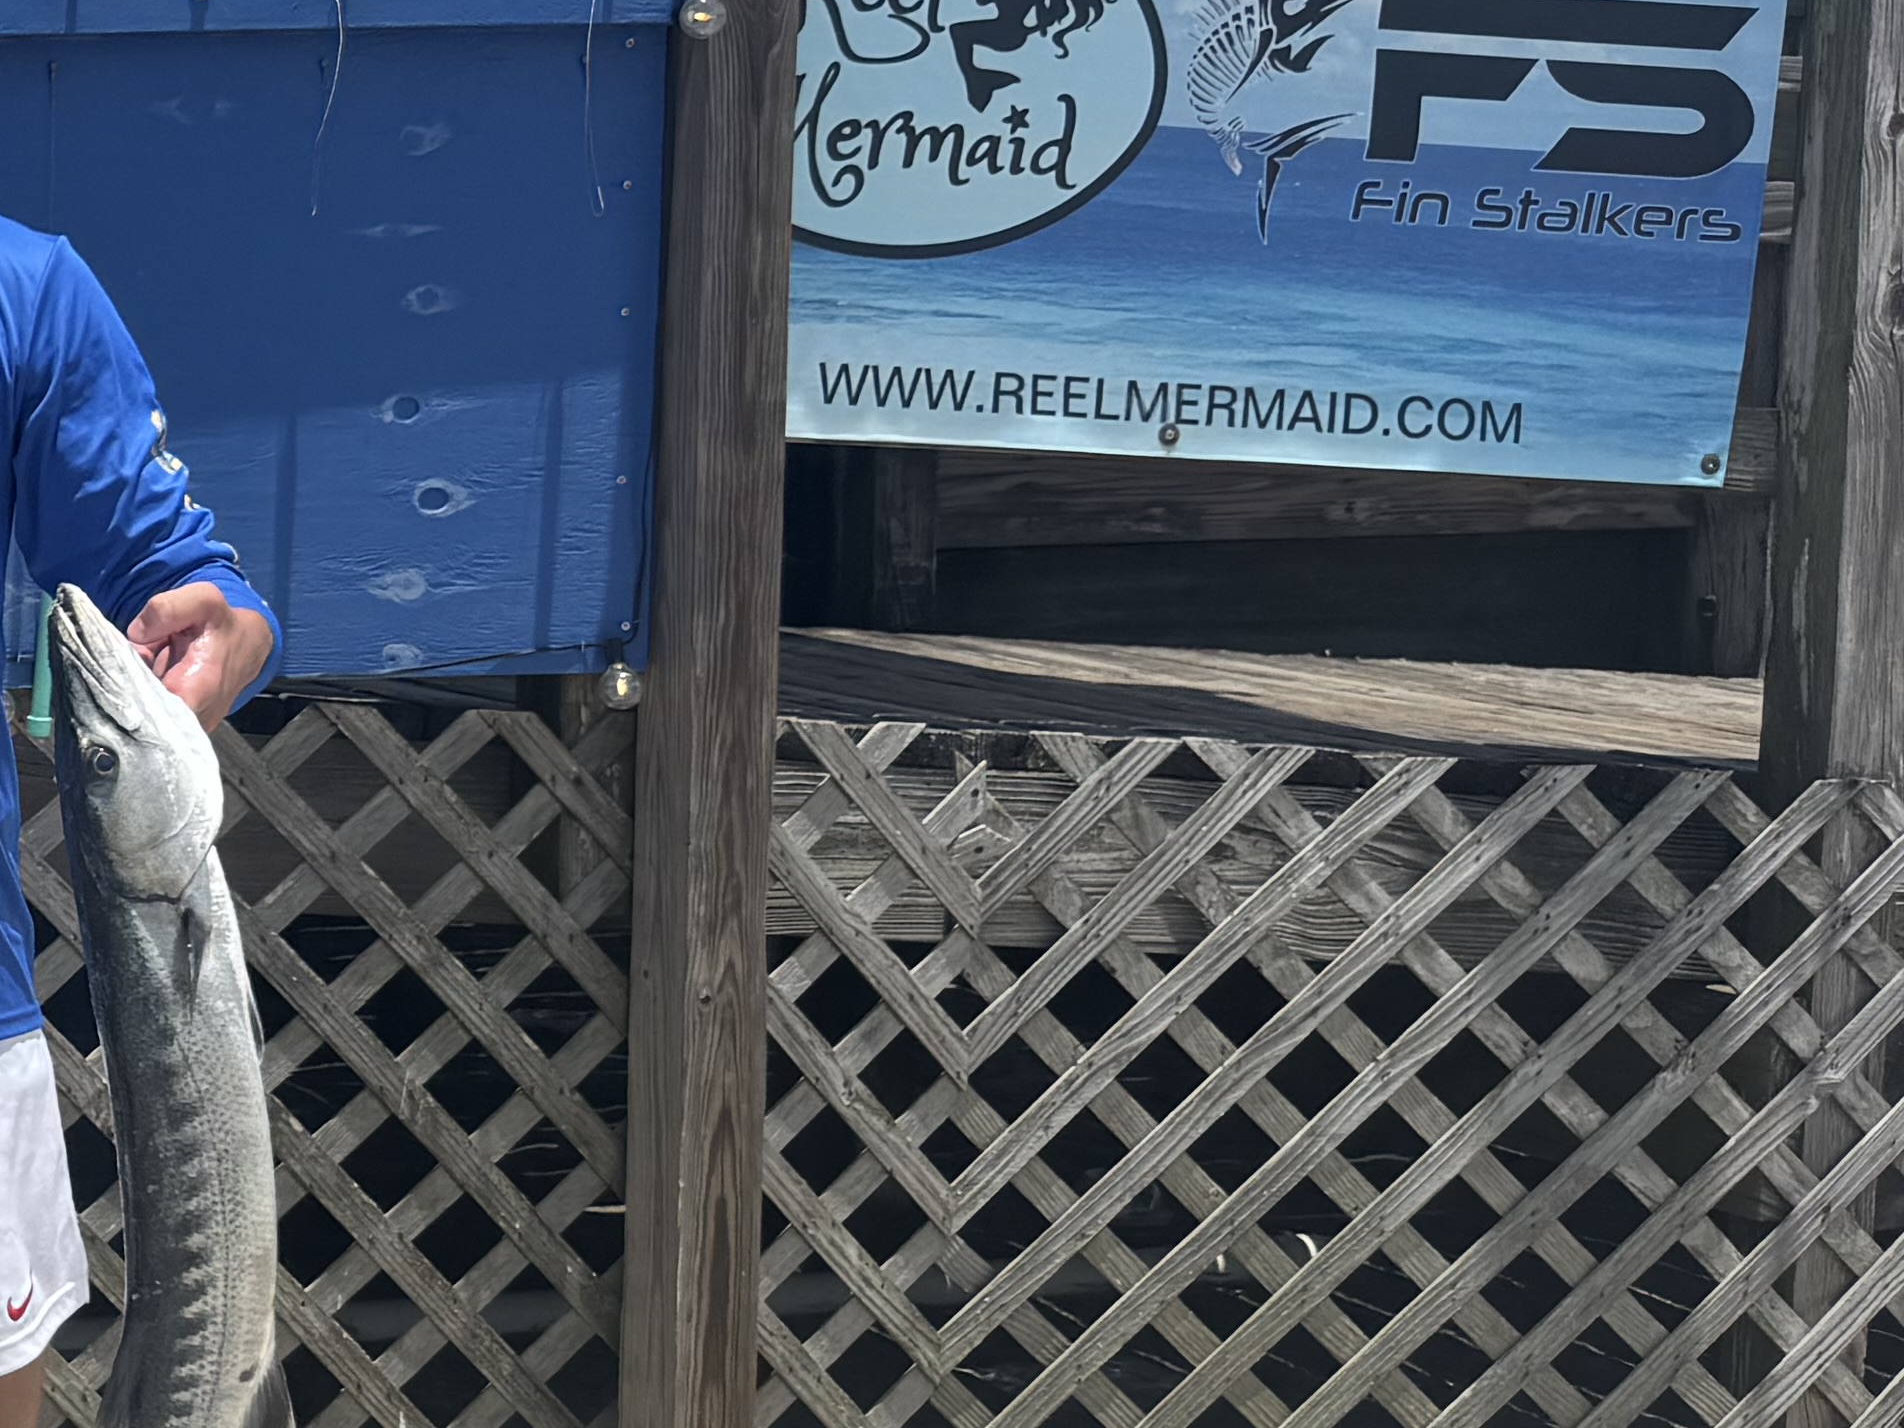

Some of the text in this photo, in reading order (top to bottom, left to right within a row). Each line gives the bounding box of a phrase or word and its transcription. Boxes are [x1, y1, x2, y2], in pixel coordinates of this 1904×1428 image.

[1349, 179, 1744, 244] Fin Stalkers
[818, 361, 1524, 445] WWW.REELMERMAID.COM
